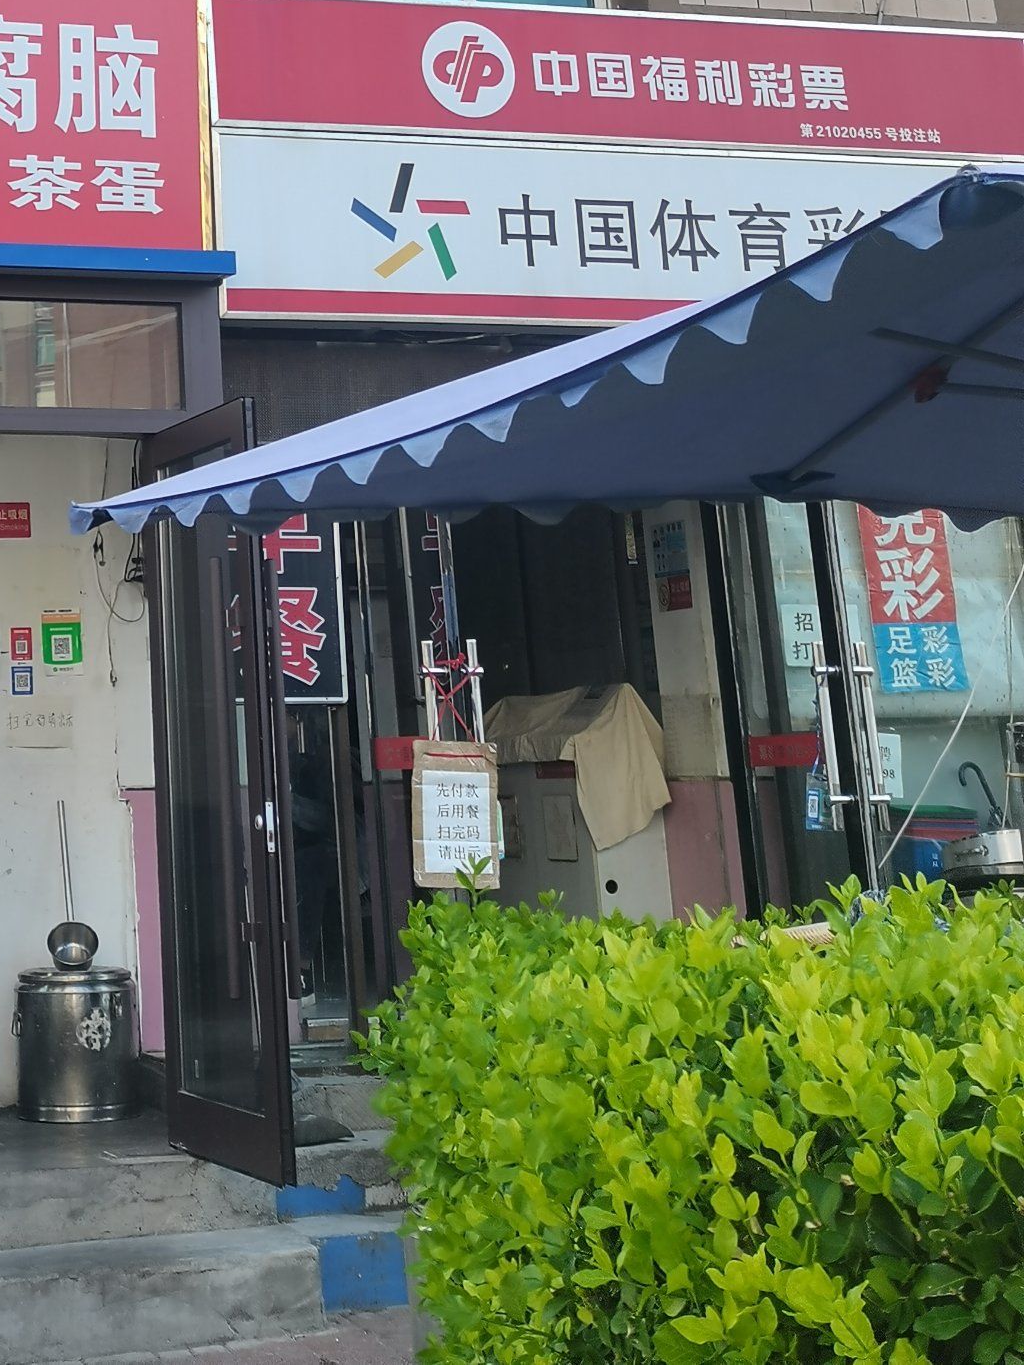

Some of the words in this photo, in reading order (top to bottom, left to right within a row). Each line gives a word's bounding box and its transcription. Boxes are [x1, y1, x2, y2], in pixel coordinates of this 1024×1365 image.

[532, 51, 849, 111] 中国福利彩票
[8, 154, 164, 214] 茶蛋
[497, 193, 866, 272] 中国体育彩
[887, 626, 952, 654] 足彩
[890, 658, 956, 688] 篮彩
[437, 783, 479, 798] 先付款
[437, 804, 480, 819] 后用餐
[438, 824, 480, 840] 扫完码
[438, 845, 481, 860] 请出示
